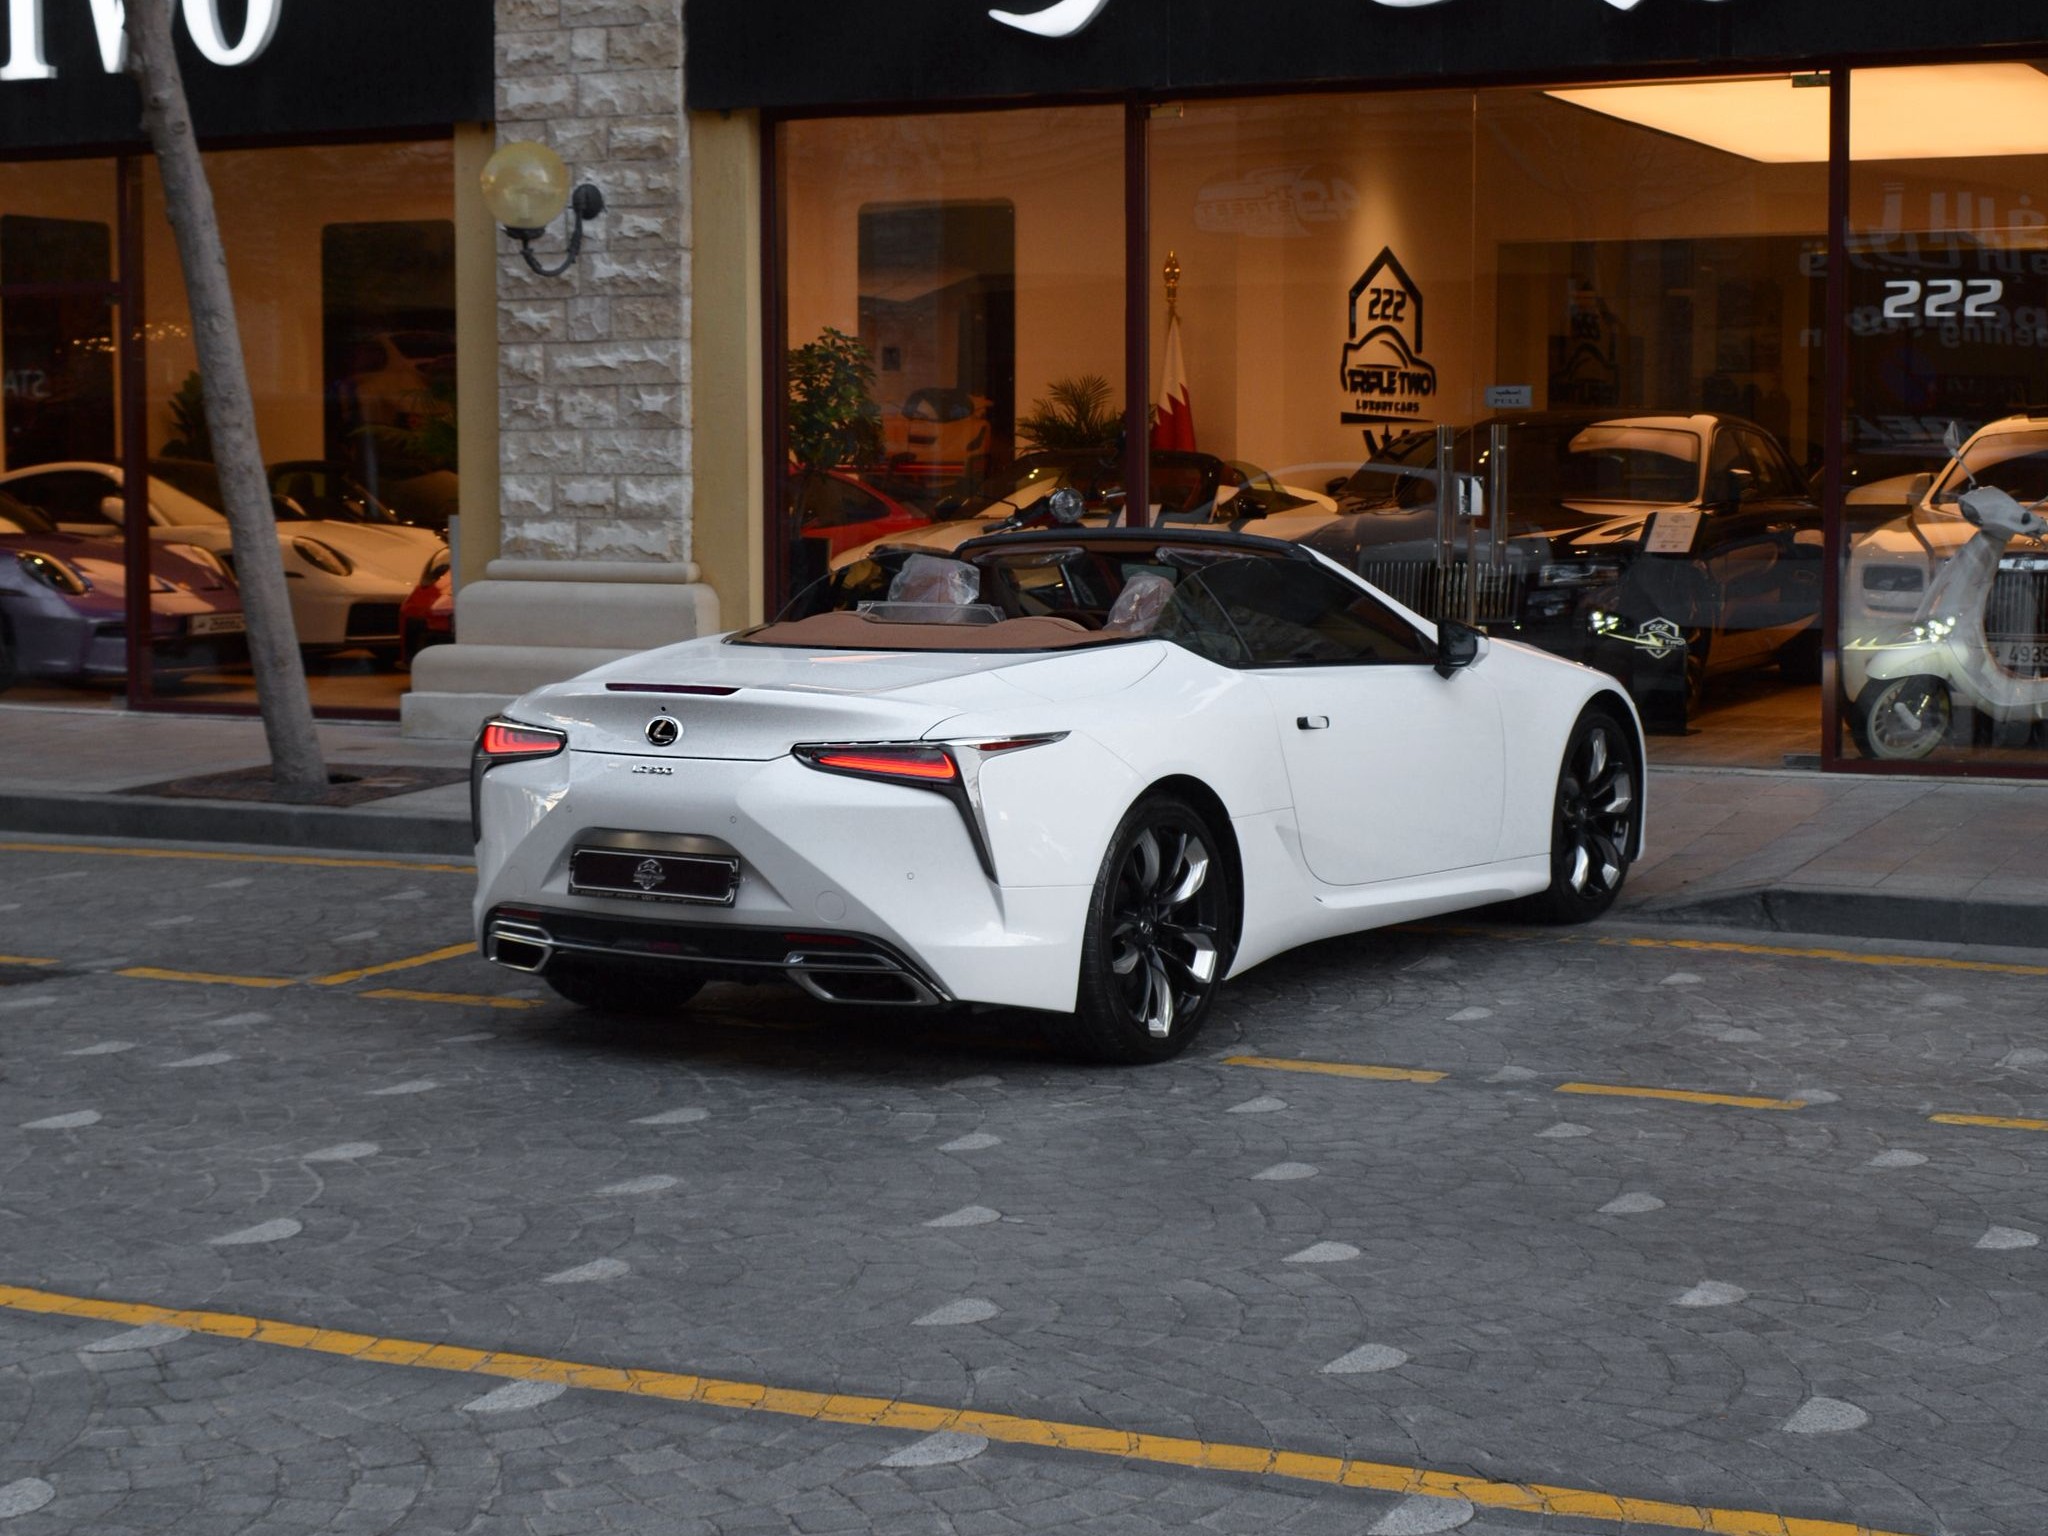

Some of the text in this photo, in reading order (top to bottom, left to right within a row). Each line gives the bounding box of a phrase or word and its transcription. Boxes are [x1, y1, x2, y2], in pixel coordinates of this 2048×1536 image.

[1368, 288, 1407, 322] 222
[1883, 279, 2003, 318] 222
[1348, 369, 1431, 396] TRIPLE TWO
[1356, 399, 1420, 412] LUXURY CARS
